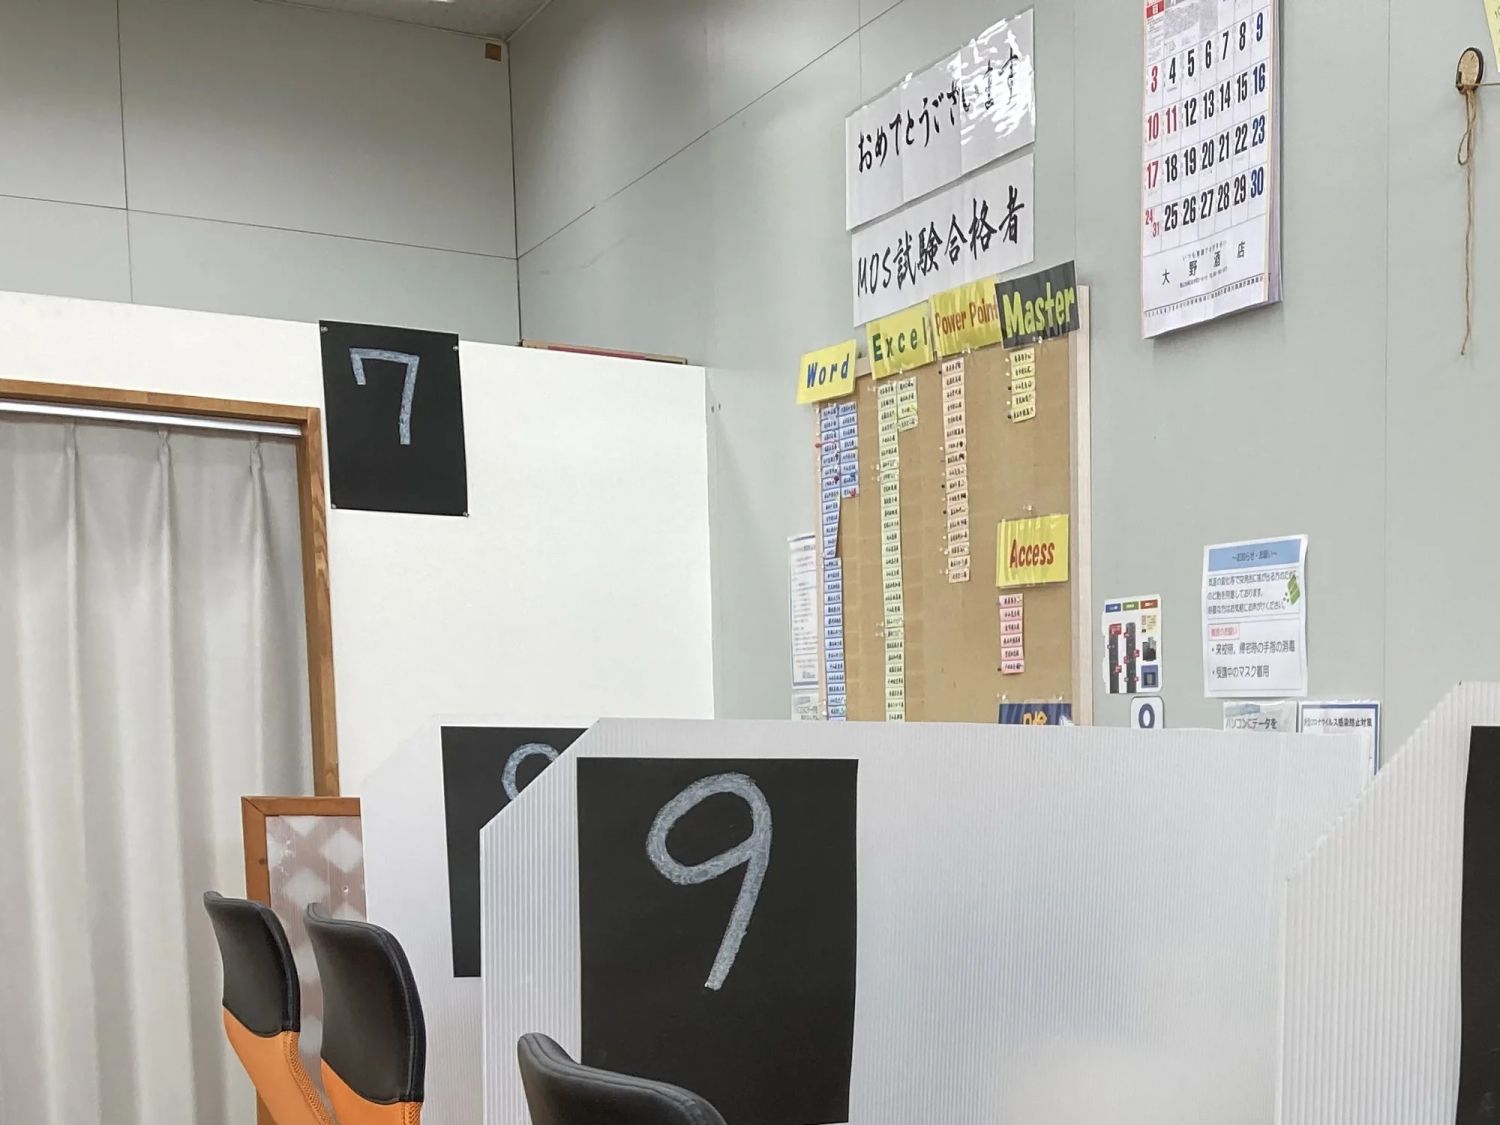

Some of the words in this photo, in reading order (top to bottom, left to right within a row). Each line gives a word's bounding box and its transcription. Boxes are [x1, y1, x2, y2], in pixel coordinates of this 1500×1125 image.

[1151, 66, 1158, 92] 3
[1169, 58, 1177, 84] 4
[1187, 49, 1195, 77] 5
[1205, 40, 1212, 69] 6
[1222, 31, 1229, 60] 7
[1239, 22, 1246, 51] 8
[1256, 12, 1264, 42] 9
[1147, 112, 1159, 141] 10
[1166, 105, 1177, 134] 11
[1184, 98, 1197, 127] 12
[1203, 90, 1214, 119] 13
[1219, 81, 1231, 111] 14
[1237, 72, 1248, 103] 15
[1253, 63, 1266, 95] 16
[1147, 160, 1159, 189] 17
[1165, 154, 1177, 183] 18
[1184, 147, 1196, 176] 19
[1202, 139, 1214, 170] 20
[1218, 132, 1230, 162] 21
[1234, 123, 1248, 155] 22
[1252, 115, 1265, 147] 23
[1145, 209, 1153, 225] 24
[1164, 203, 1178, 231] 25
[1182, 196, 1196, 226] 26
[1200, 189, 1214, 219] 27
[1217, 182, 1230, 212] 28
[1234, 174, 1246, 205] 29
[1250, 167, 1264, 198] 30
[1152, 222, 1160, 238] 31
[857, 185, 1025, 298] MOS試験合格者
[872, 316, 928, 362] Excel
[935, 311, 967, 337] Power
[1002, 281, 1076, 338] Master
[350, 347, 420, 445] 7
[806, 353, 849, 388] Word
[1009, 539, 1055, 568] Access
[646, 771, 773, 991] 9
